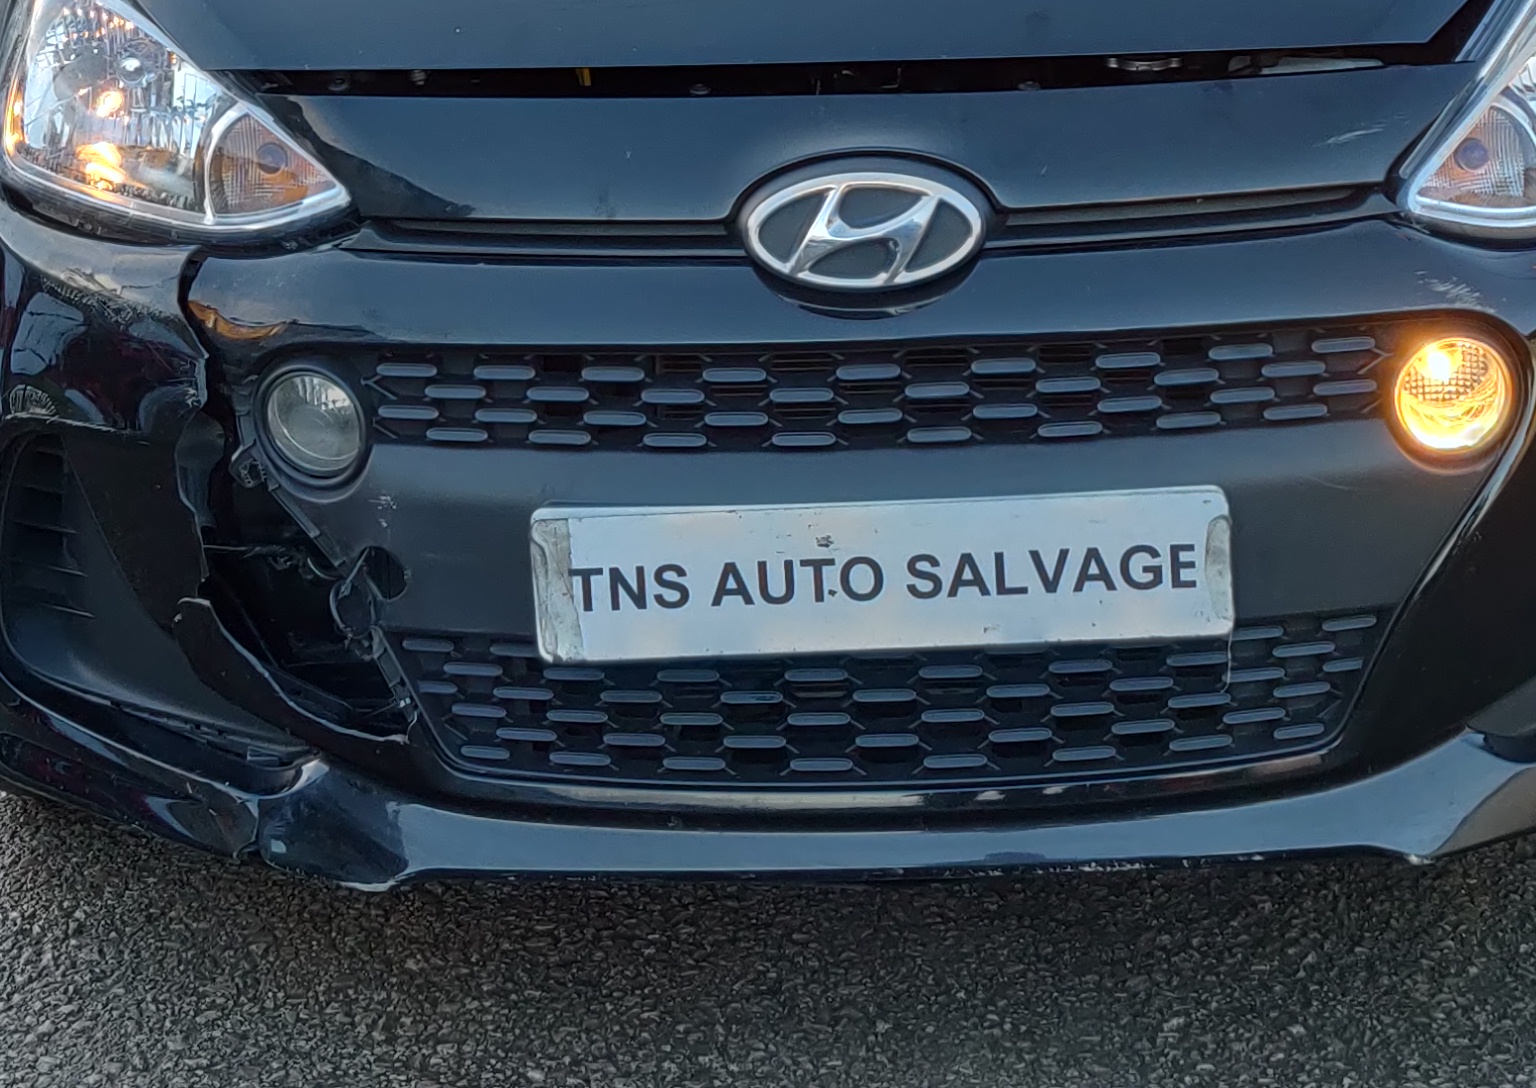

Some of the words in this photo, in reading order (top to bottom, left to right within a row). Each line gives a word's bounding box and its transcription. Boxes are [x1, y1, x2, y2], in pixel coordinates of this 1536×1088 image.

[568, 563, 690, 614] TNS
[710, 555, 885, 608] AUTO
[906, 542, 1199, 602] SALVAGE
